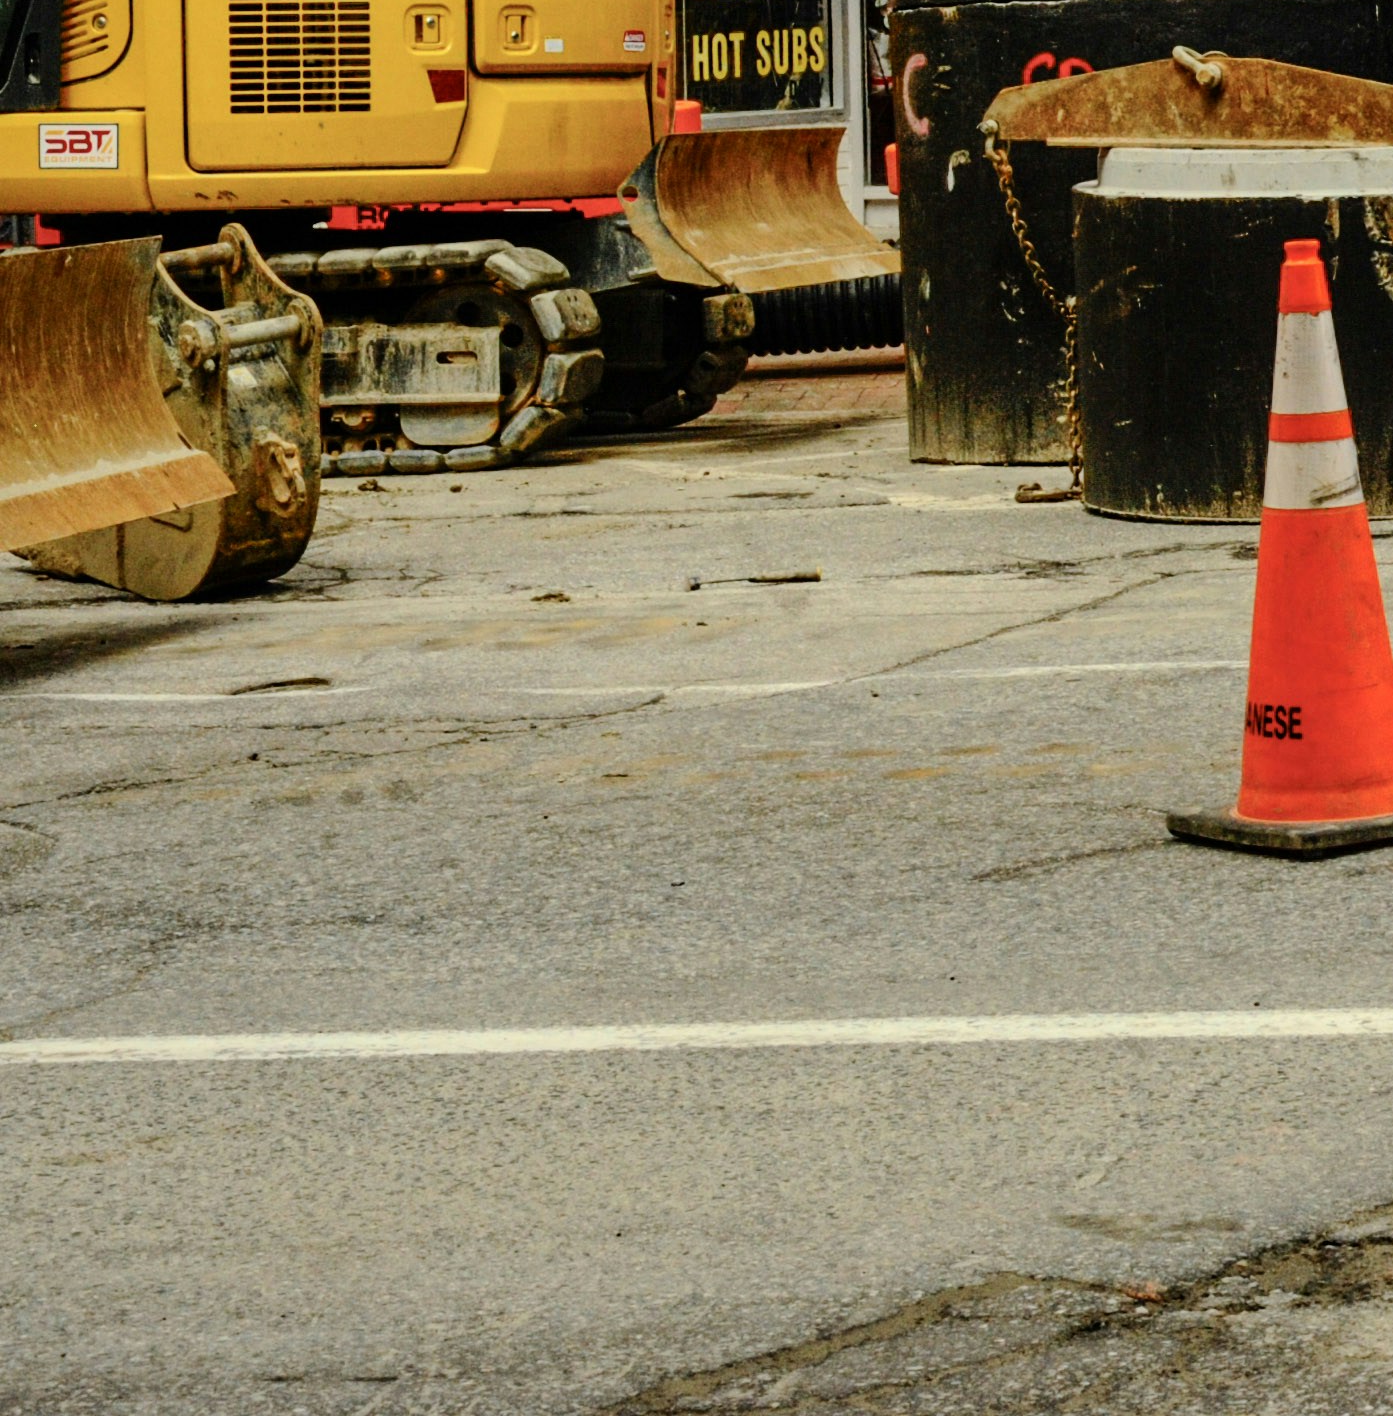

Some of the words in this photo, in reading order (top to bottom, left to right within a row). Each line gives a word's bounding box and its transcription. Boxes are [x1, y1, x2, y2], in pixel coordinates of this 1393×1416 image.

[691, 31, 745, 82] HOT
[756, 26, 825, 77] SUBS
[44, 129, 113, 155] SBT
[43, 155, 114, 164] EQUIPMENT
